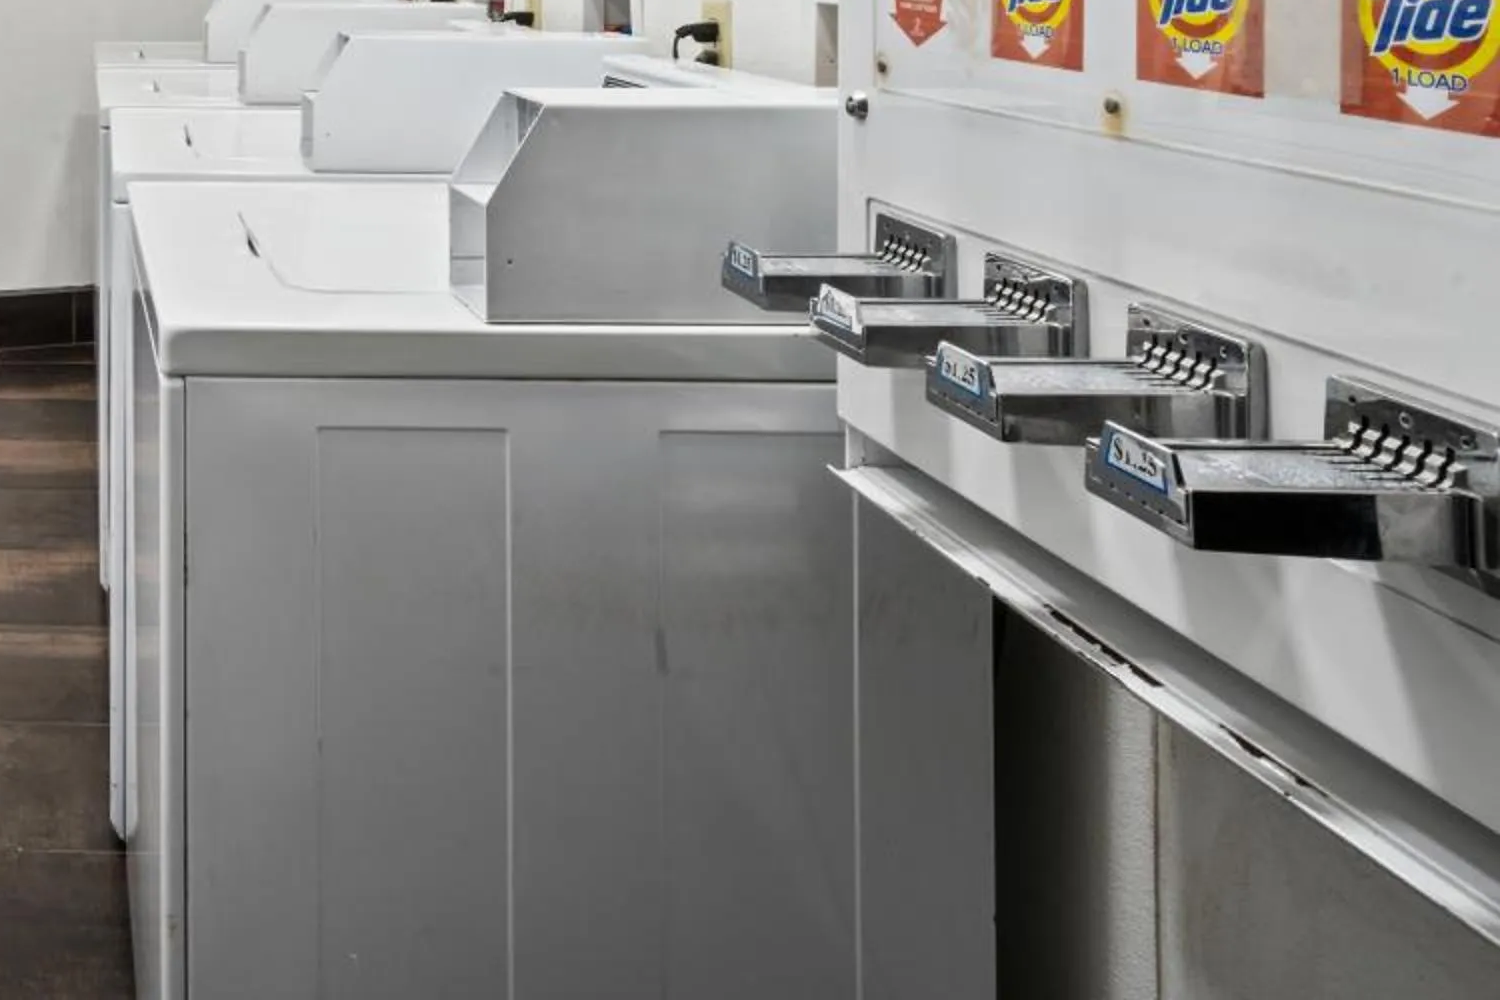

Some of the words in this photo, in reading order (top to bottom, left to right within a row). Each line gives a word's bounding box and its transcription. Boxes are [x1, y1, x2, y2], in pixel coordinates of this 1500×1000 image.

[1182, 38, 1224, 55] LOAD
[1391, 66, 1400, 84] 1
[1406, 69, 1469, 92] LOAD
[1113, 437, 1157, 477] $1.25
